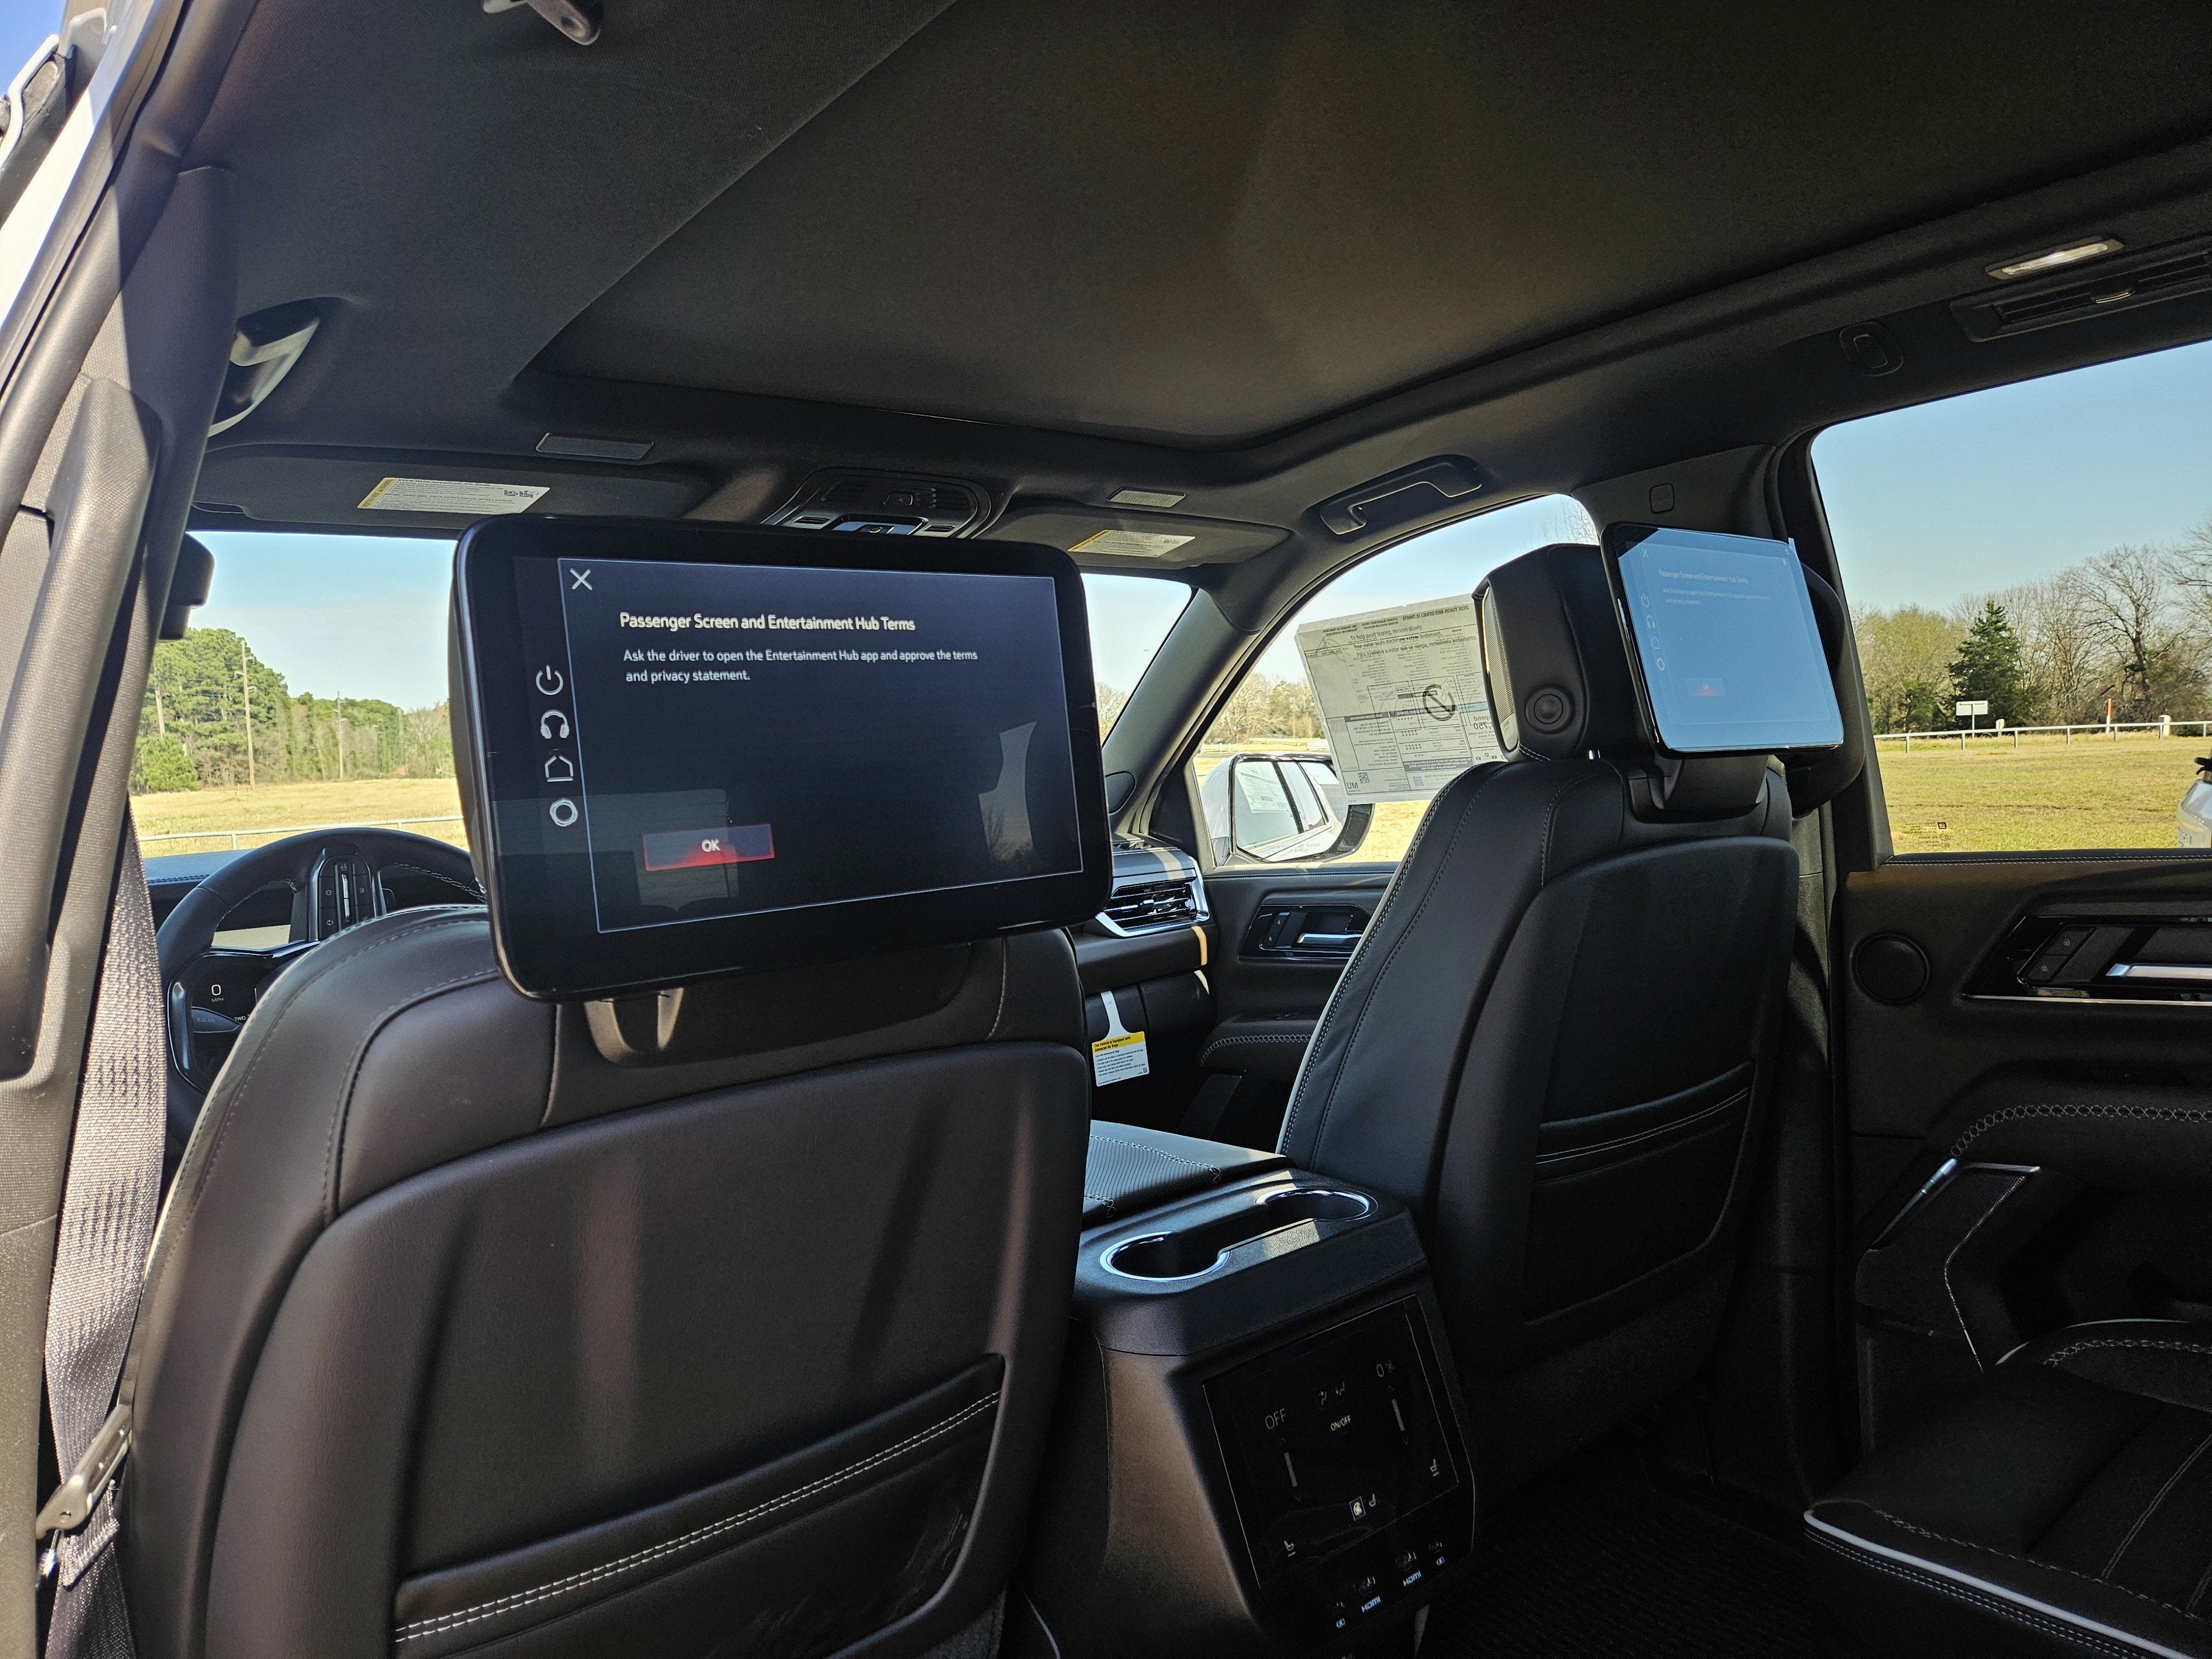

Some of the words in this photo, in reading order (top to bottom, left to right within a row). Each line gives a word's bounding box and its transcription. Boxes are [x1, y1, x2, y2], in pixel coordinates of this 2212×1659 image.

[619, 612, 691, 632] Passenger
[693, 613, 739, 629] Screen
[740, 614, 765, 629] and
[768, 614, 854, 630] Entertainment
[855, 615, 880, 630] Hub
[880, 616, 916, 631] Terms
[623, 649, 645, 661] Ask
[647, 648, 666, 661] the
[669, 648, 700, 661] driver
[702, 650, 714, 661] to
[717, 651, 744, 664] open
[745, 648, 764, 661] the
[765, 649, 838, 661] Entertainment
[838, 648, 859, 661] Hub
[860, 651, 879, 663] app
[880, 649, 898, 660] and
[899, 651, 935, 662] approve
[936, 649, 952, 660] the
[952, 651, 978, 660] terms
[625, 669, 648, 682] and
[651, 670, 690, 684] privacy
[692, 670, 750, 682] statement.
[701, 838, 721, 852] OK
[211, 984, 221, 996] 0
[1376, 1364, 1385, 1378] 0
[1265, 1407, 1287, 1430] OFF
[1331, 1415, 1352, 1431] ON/OFF
[1402, 1570, 1422, 1587] HDMI
[1361, 1595, 1381, 1613] HDMI
